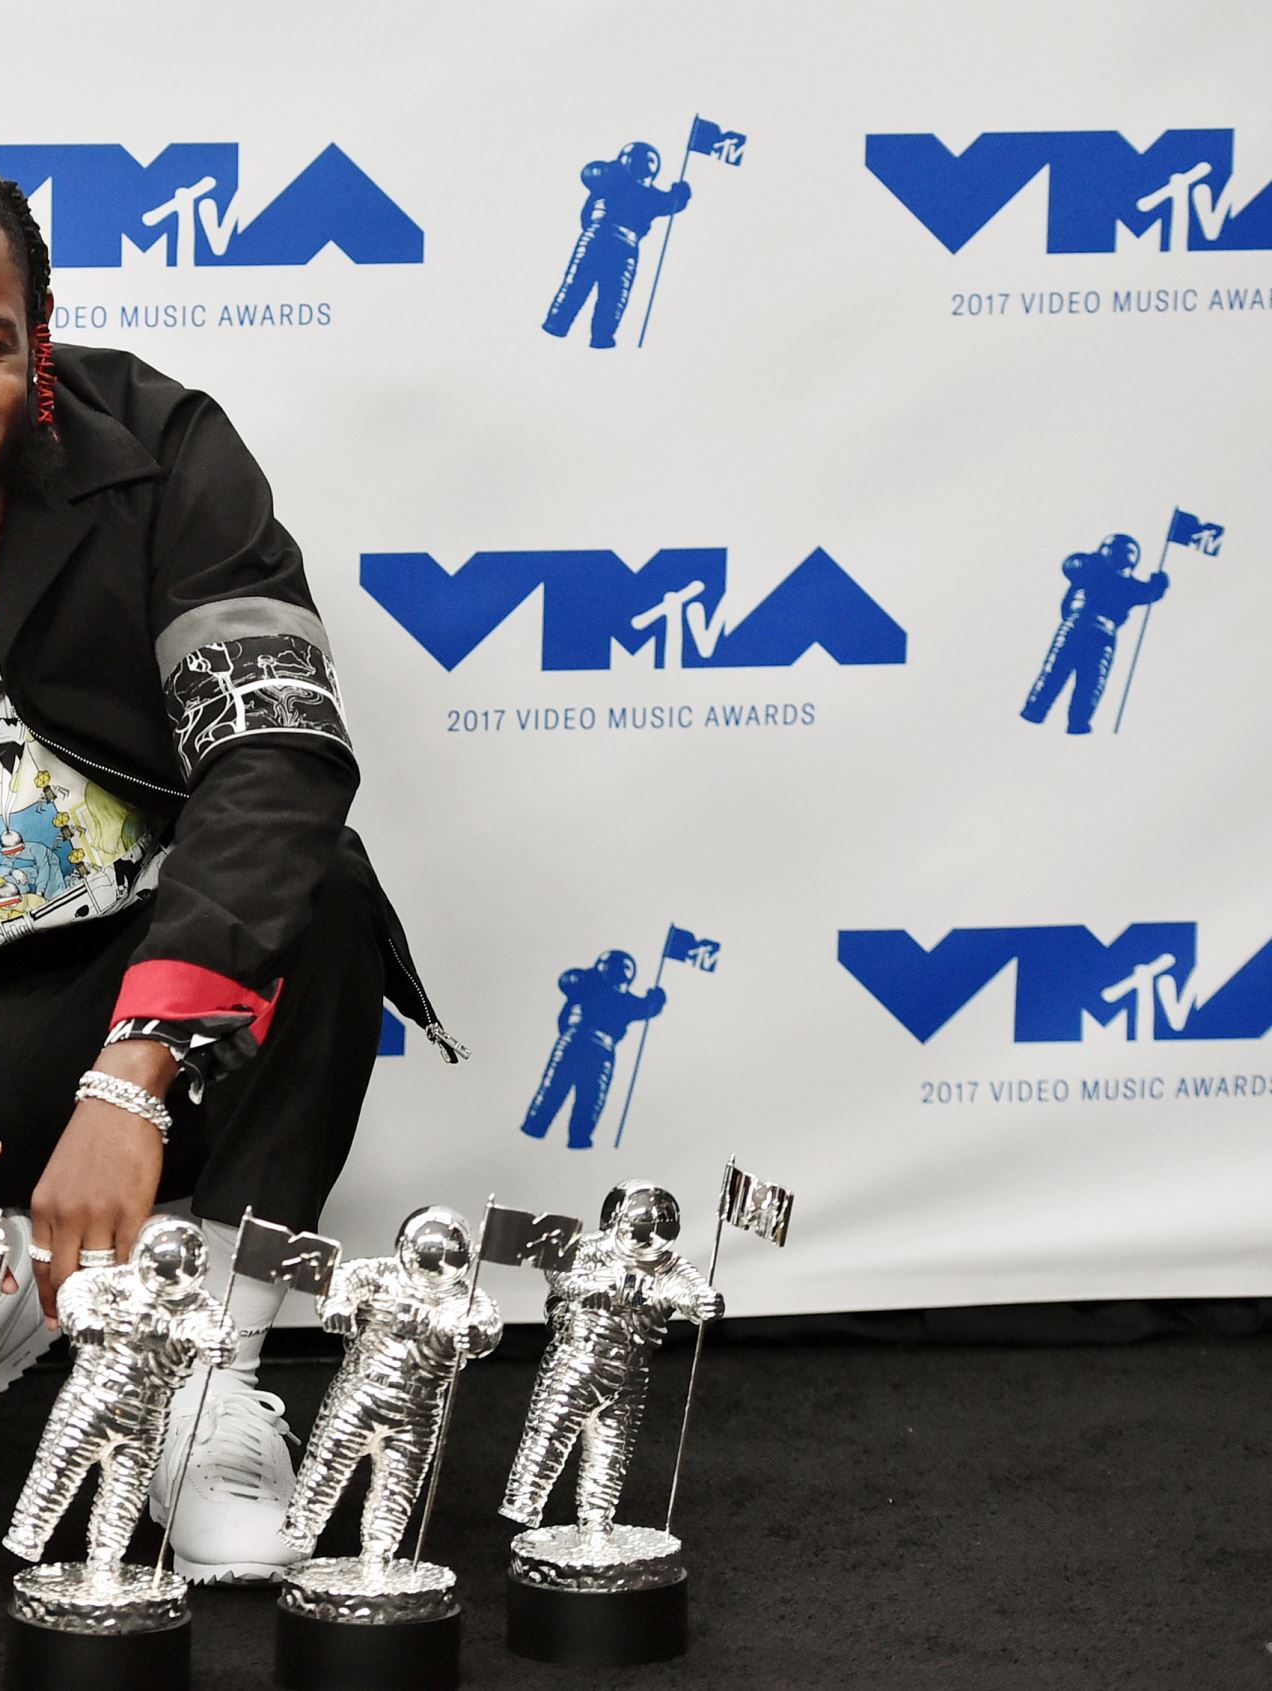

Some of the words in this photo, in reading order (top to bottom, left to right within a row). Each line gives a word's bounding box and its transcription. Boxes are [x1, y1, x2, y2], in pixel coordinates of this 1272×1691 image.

[55, 305, 108, 329] DEO
[120, 304, 207, 328] MUSIC
[217, 302, 332, 327] AWARDS
[951, 292, 1011, 317] 2017
[1020, 290, 1101, 315] VIDEO
[1112, 288, 1198, 313] MUSIC
[1208, 287, 1272, 311] AWA
[446, 709, 507, 733] 2017
[515, 706, 596, 731] VIDEO
[608, 705, 694, 730] MUSIC
[703, 702, 816, 728] AWARDS
[921, 1081, 979, 1105] 2017
[989, 1079, 1069, 1103] VIDEO
[1081, 1077, 1165, 1101] MUSIC
